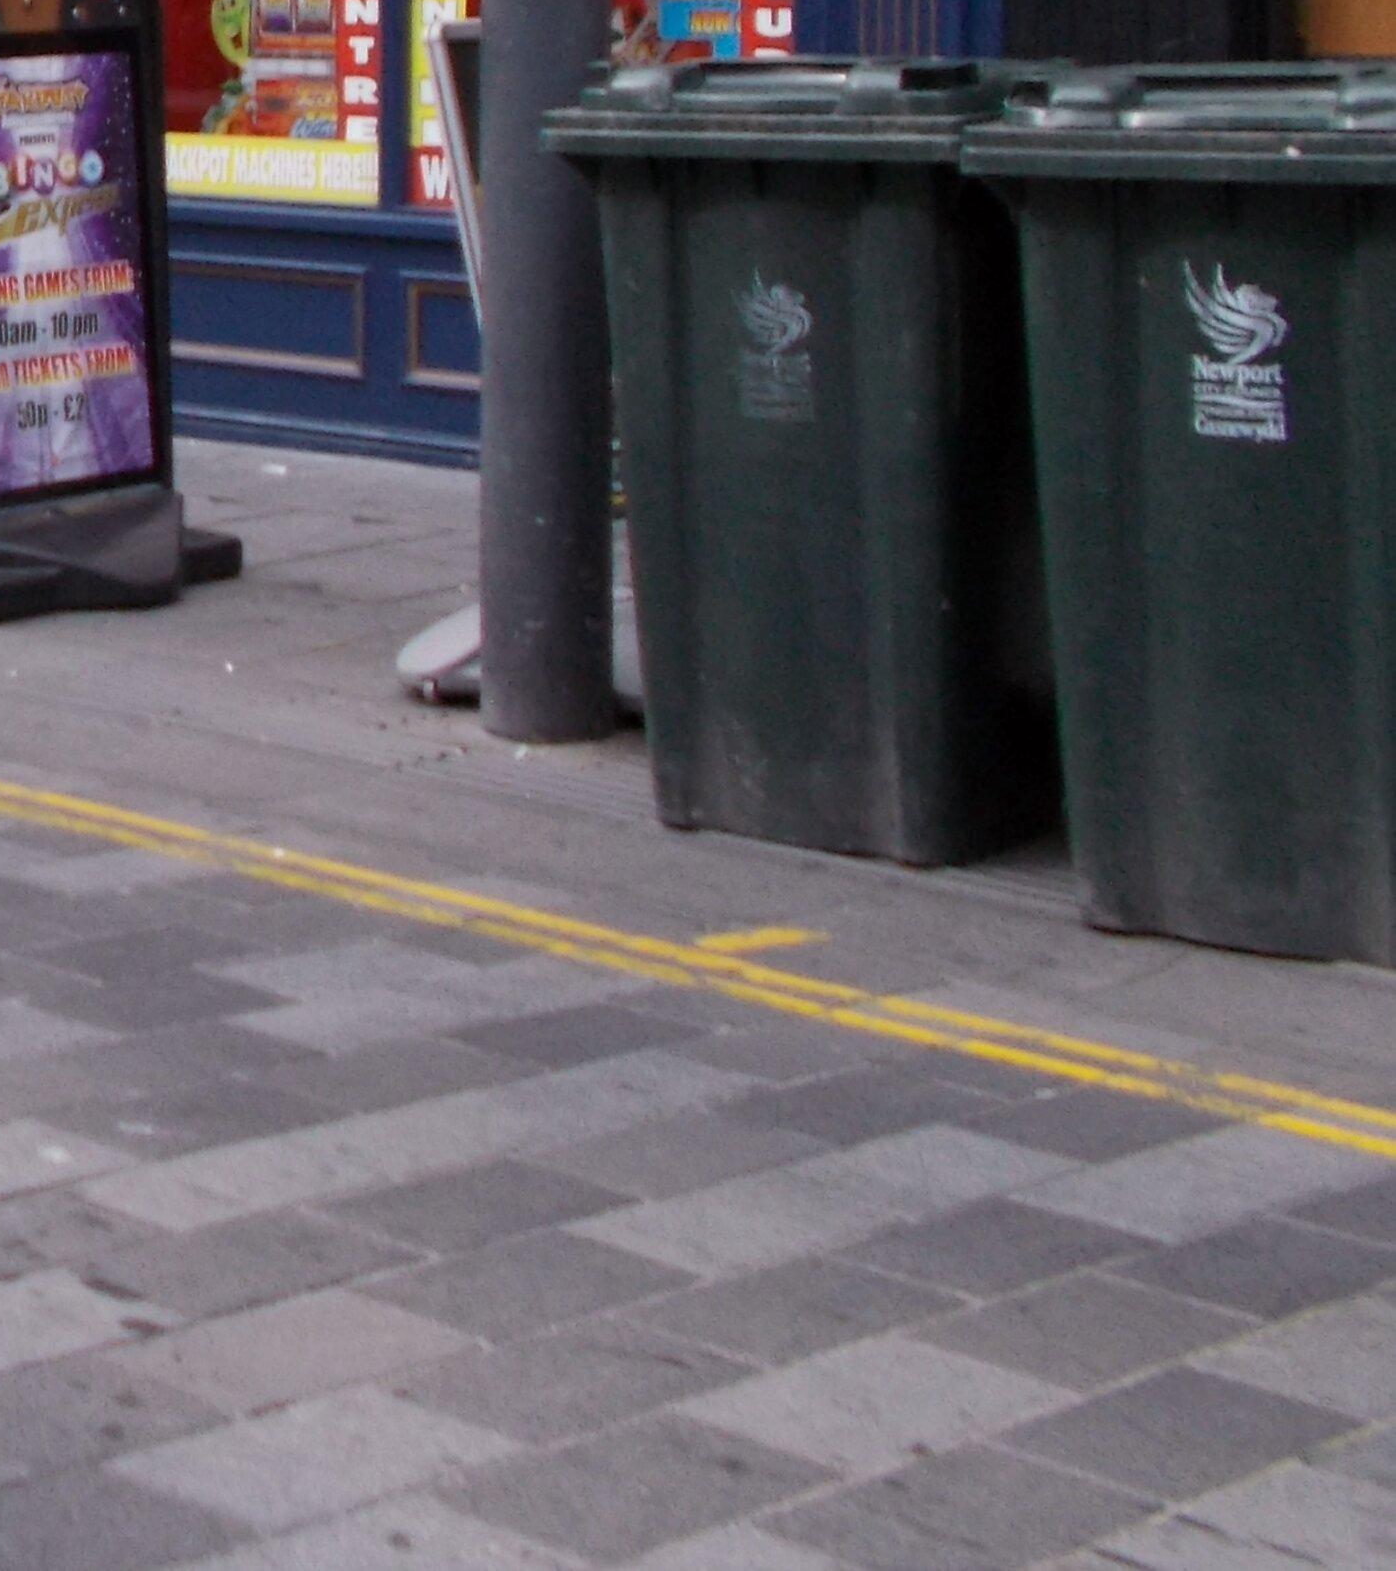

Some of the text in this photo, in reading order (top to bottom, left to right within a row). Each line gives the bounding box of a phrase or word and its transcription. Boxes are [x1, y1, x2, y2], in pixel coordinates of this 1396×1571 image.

[165, 146, 229, 188] ACKPOT
[234, 147, 317, 192] MACHINES
[23, 267, 81, 302] GAMES
[13, 350, 83, 386] TICKETS
